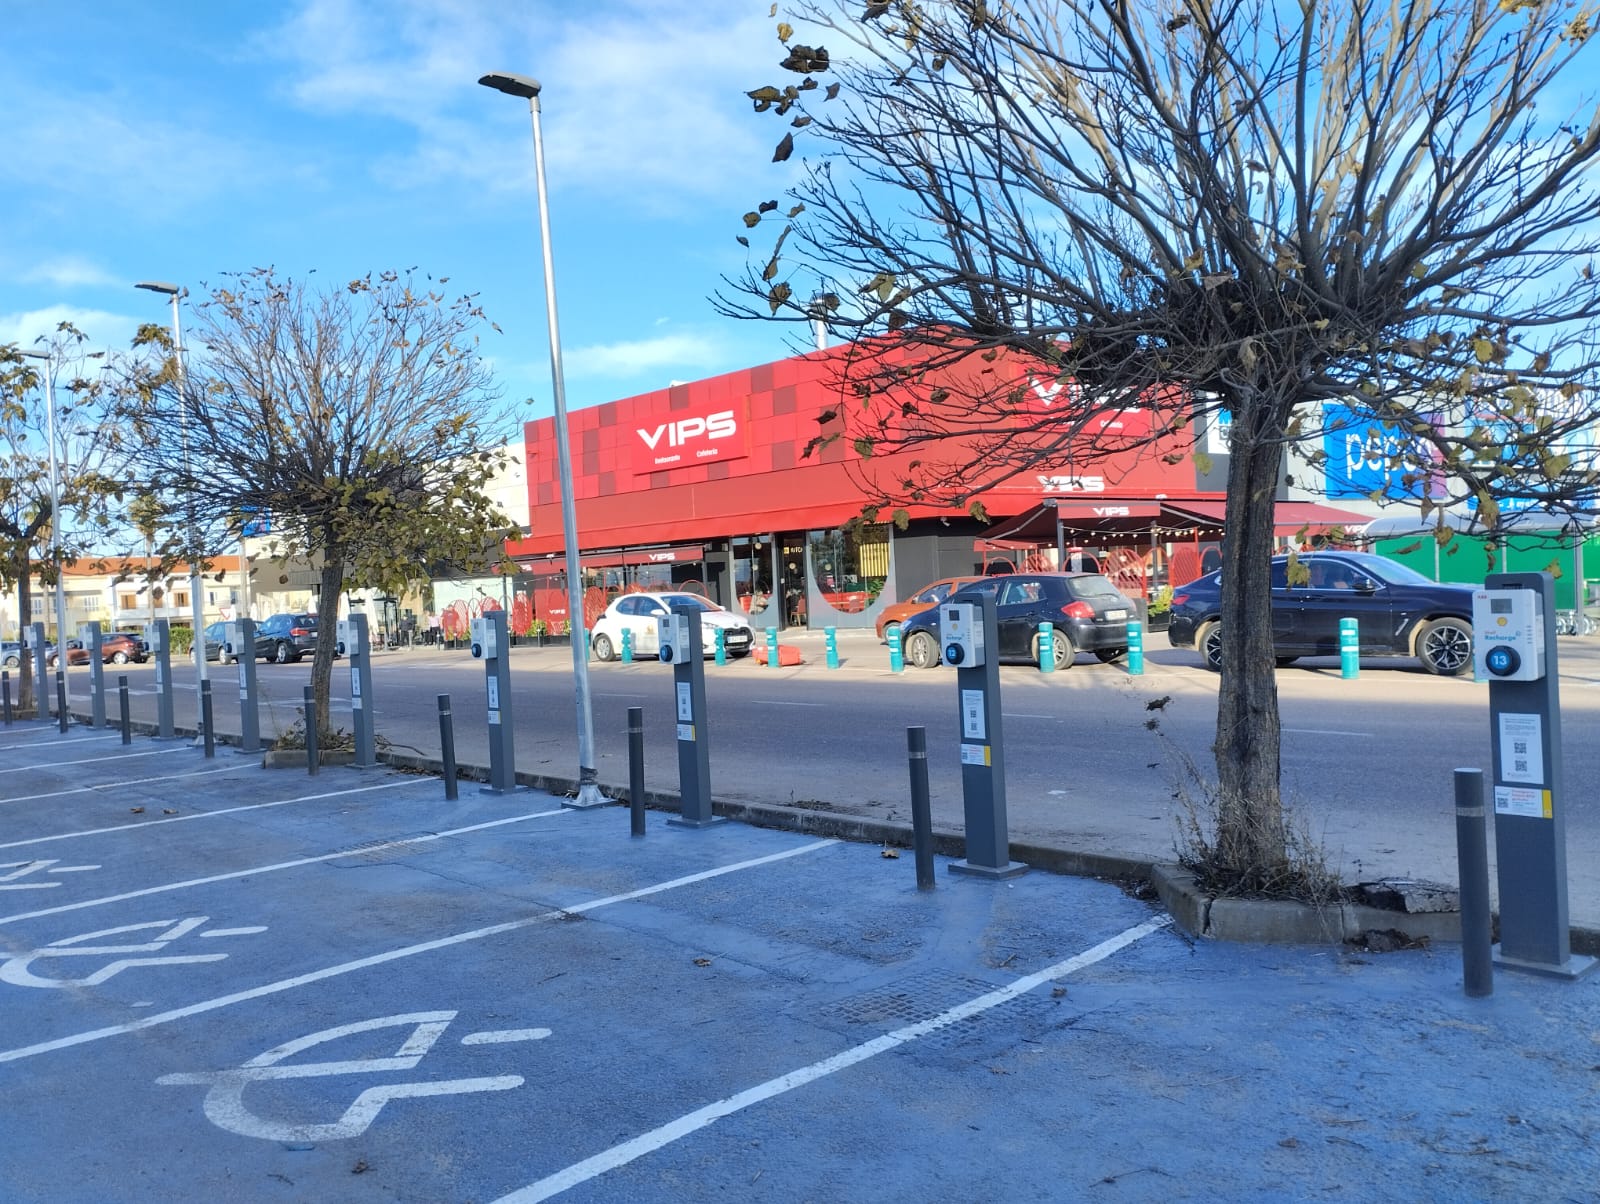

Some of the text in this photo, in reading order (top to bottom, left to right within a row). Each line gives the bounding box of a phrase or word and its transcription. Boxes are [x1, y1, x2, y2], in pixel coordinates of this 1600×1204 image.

[636, 410, 737, 451] VIPS
[1037, 475, 1105, 492] VIPS
[1093, 507, 1130, 516] VIPS
[649, 552, 675, 561] VIPS
[1494, 655, 1507, 665] 13
